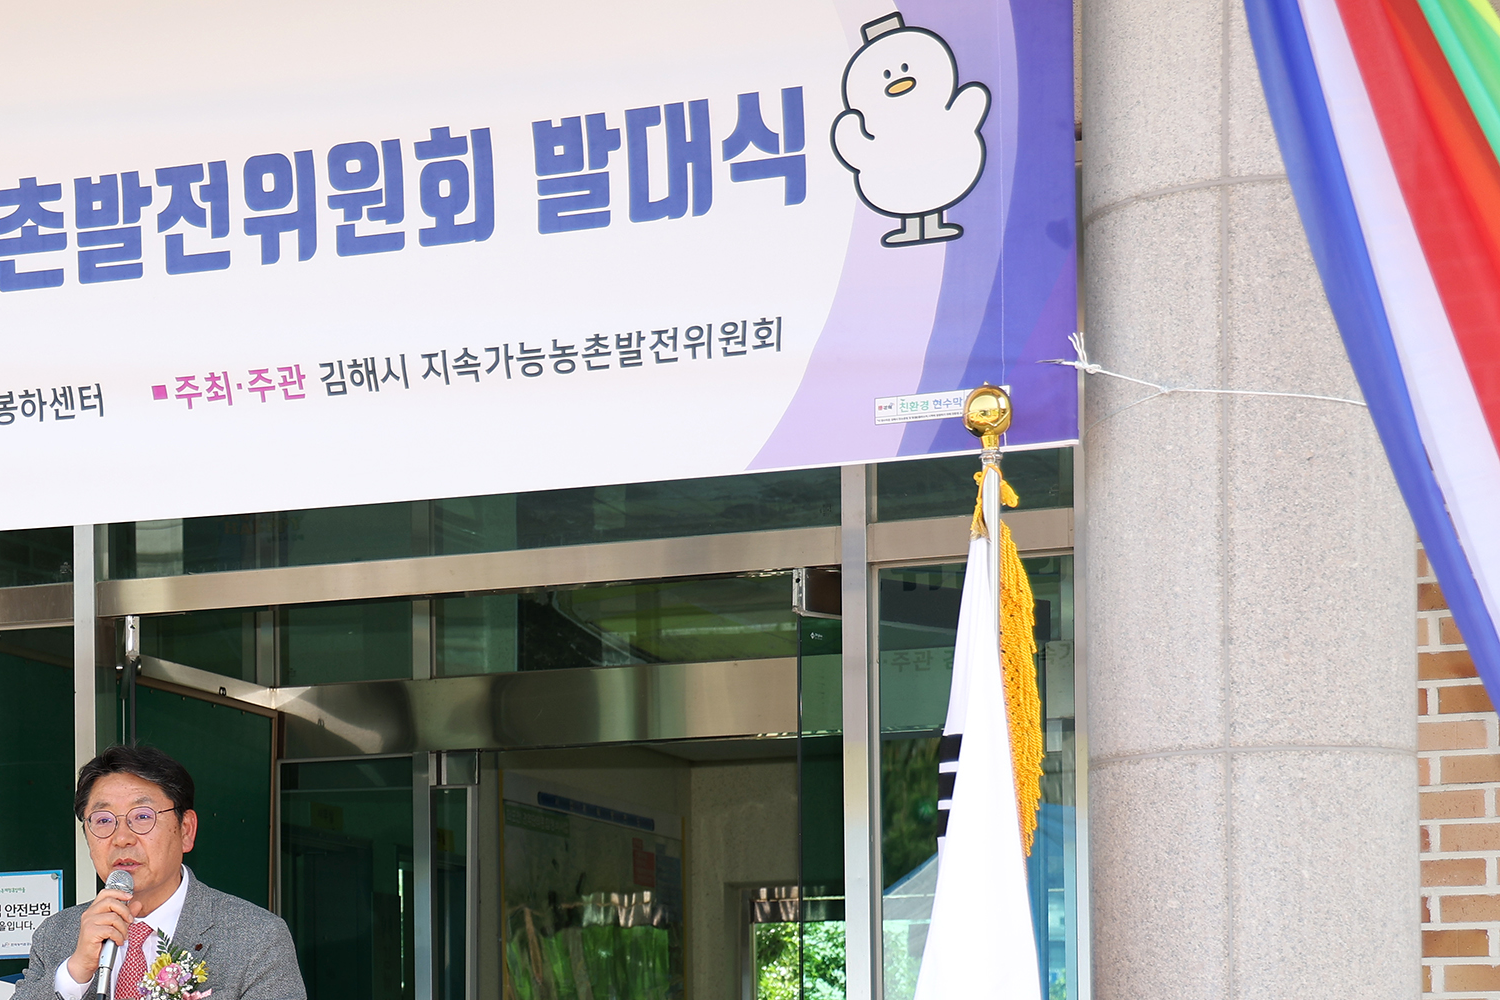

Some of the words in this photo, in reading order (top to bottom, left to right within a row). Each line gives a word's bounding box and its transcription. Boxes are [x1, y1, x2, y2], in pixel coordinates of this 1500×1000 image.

[531, 86, 807, 235] 발대식
[318, 353, 409, 398] 김해시
[420, 316, 784, 386] 지속가능농촌발전위원회
[899, 399, 930, 413] 친환경
[932, 397, 963, 410] 현수막
[5, 902, 51, 917] 안전보험
